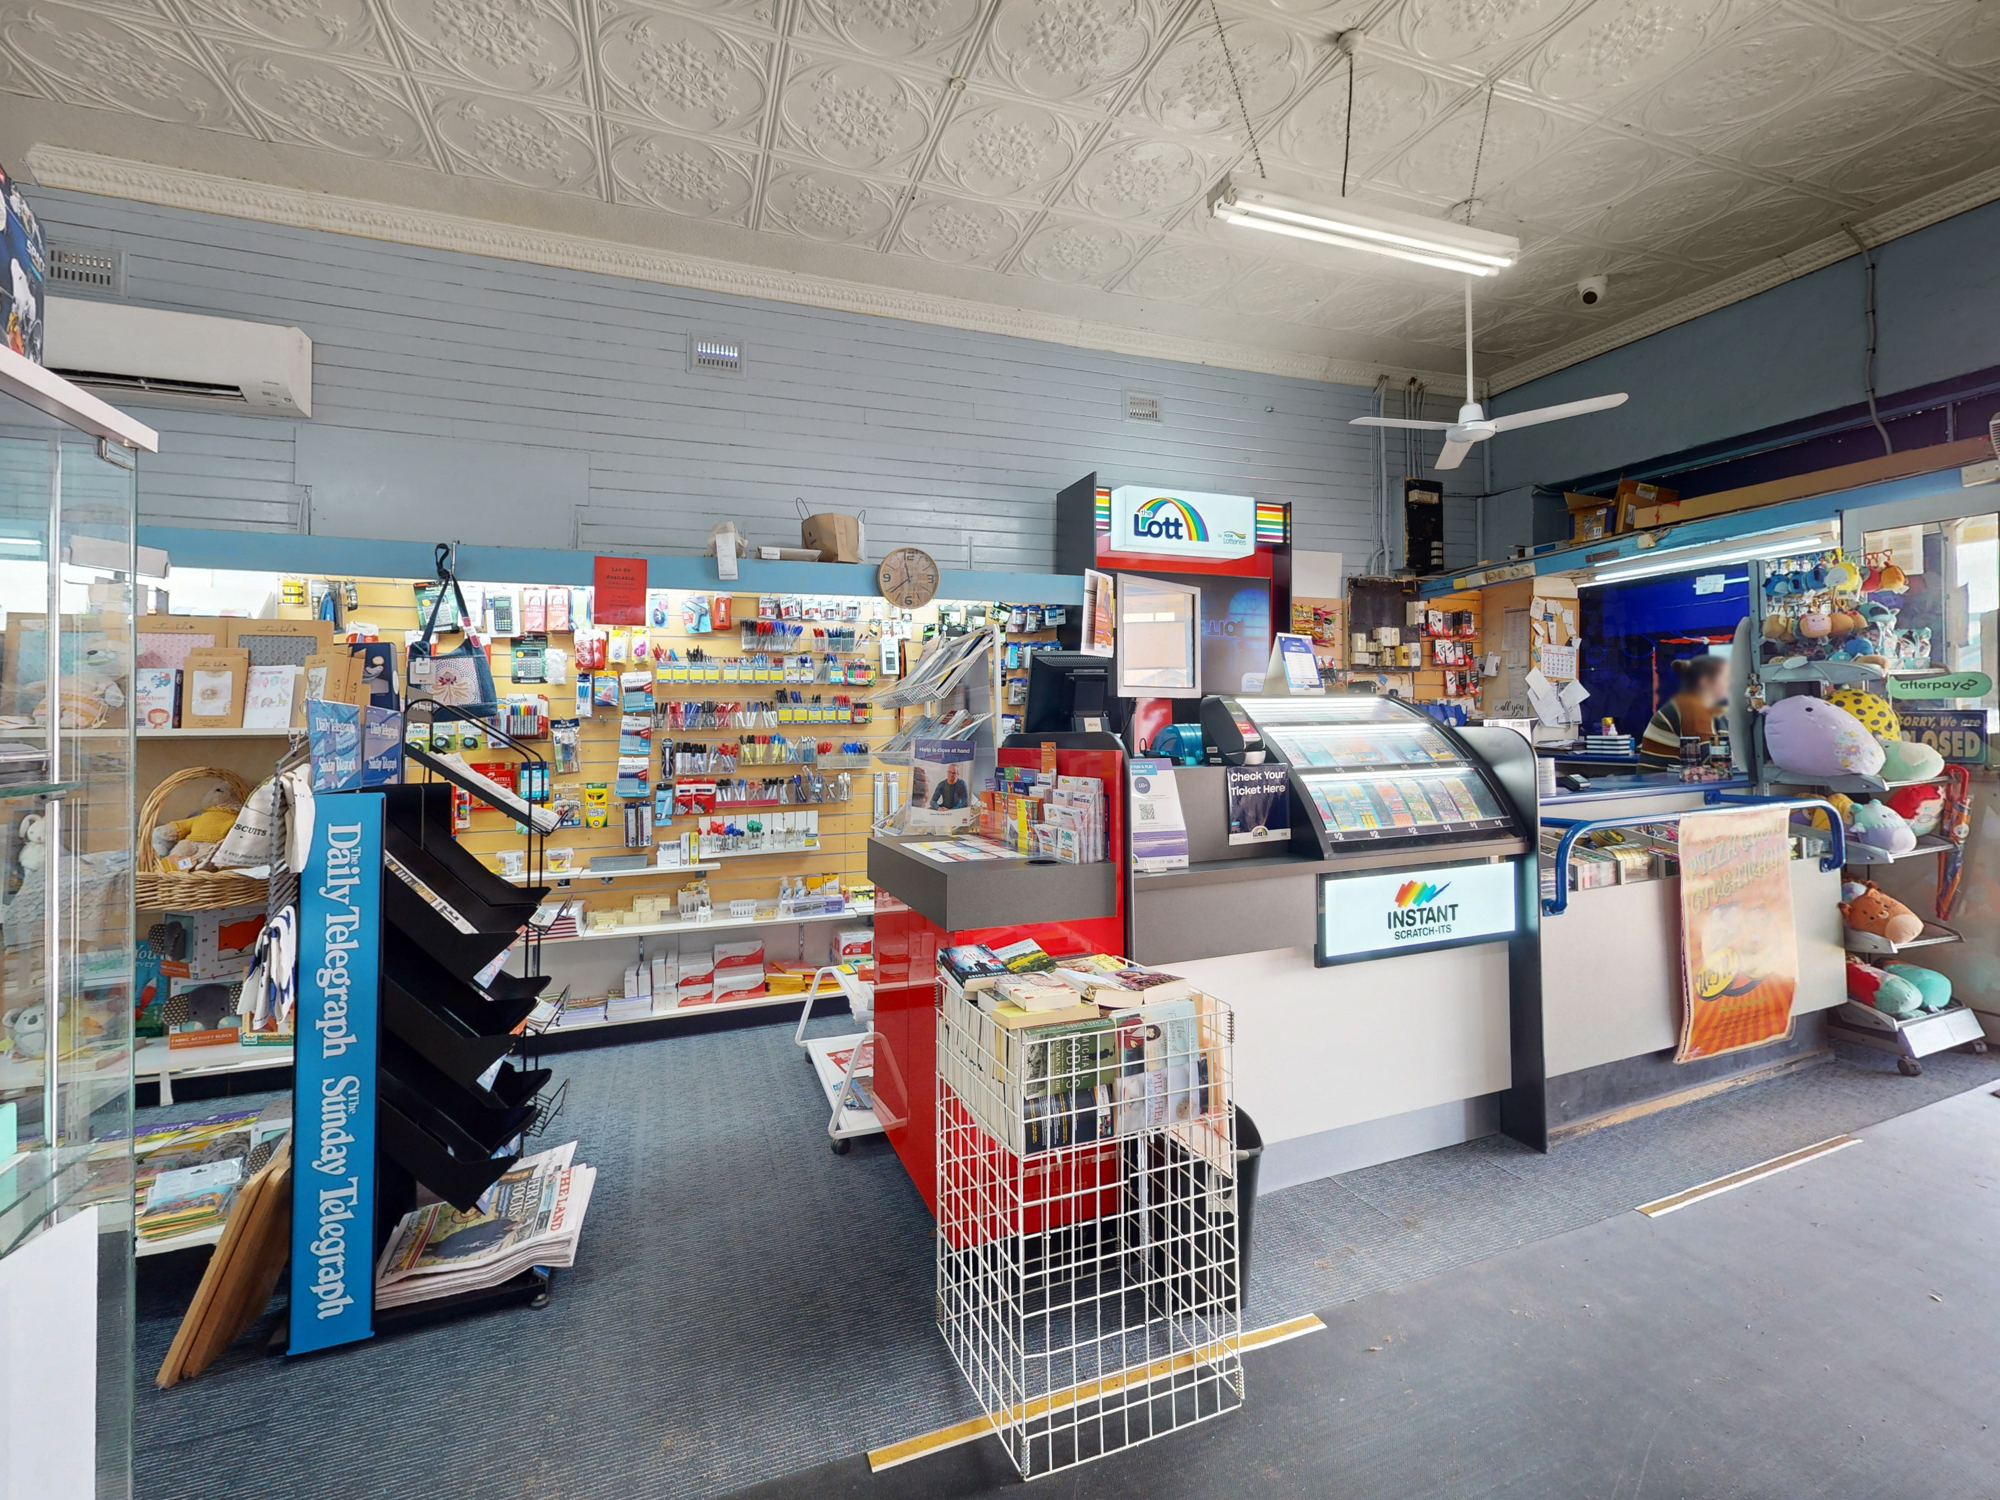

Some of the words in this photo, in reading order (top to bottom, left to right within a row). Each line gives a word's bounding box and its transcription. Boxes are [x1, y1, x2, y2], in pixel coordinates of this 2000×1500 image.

[1141, 509, 1152, 517] the
[1134, 513, 1183, 540] Lott
[1223, 537, 1247, 546] Lotteries
[882, 573, 892, 582] 9
[927, 574, 934, 584] 3
[904, 596, 913, 606] 6
[1900, 680, 1961, 691] afterpay
[1940, 716, 1958, 727] We
[1960, 718, 1981, 727] are
[1230, 772, 1262, 782] Check
[1264, 770, 1285, 780] Your
[1231, 786, 1262, 796] Ticket
[1263, 784, 1286, 794] Here
[1334, 832, 1344, 840] $2
[1370, 830, 1380, 838] $2
[1408, 827, 1418, 835] $2
[1443, 824, 1452, 832] $1
[1470, 822, 1478, 830] $1
[1494, 819, 1503, 827] $1
[318, 822, 362, 906] Daily
[350, 846, 362, 865] The
[1388, 904, 1459, 930] INSTANT
[1394, 924, 1452, 940] SCRATCH-ITS
[315, 906, 360, 1060] Telegraph
[1167, 1011, 1176, 1044] Fowers
[1081, 1035, 1090, 1081] MICHAL
[348, 1089, 361, 1114] The
[312, 1075, 360, 1176] Sunday
[523, 1177, 541, 1211] FERAL
[558, 1168, 572, 1196] THE
[508, 1180, 528, 1218] FOCUS
[550, 1199, 567, 1232] LAND
[310, 1176, 360, 1320] Telegraph
